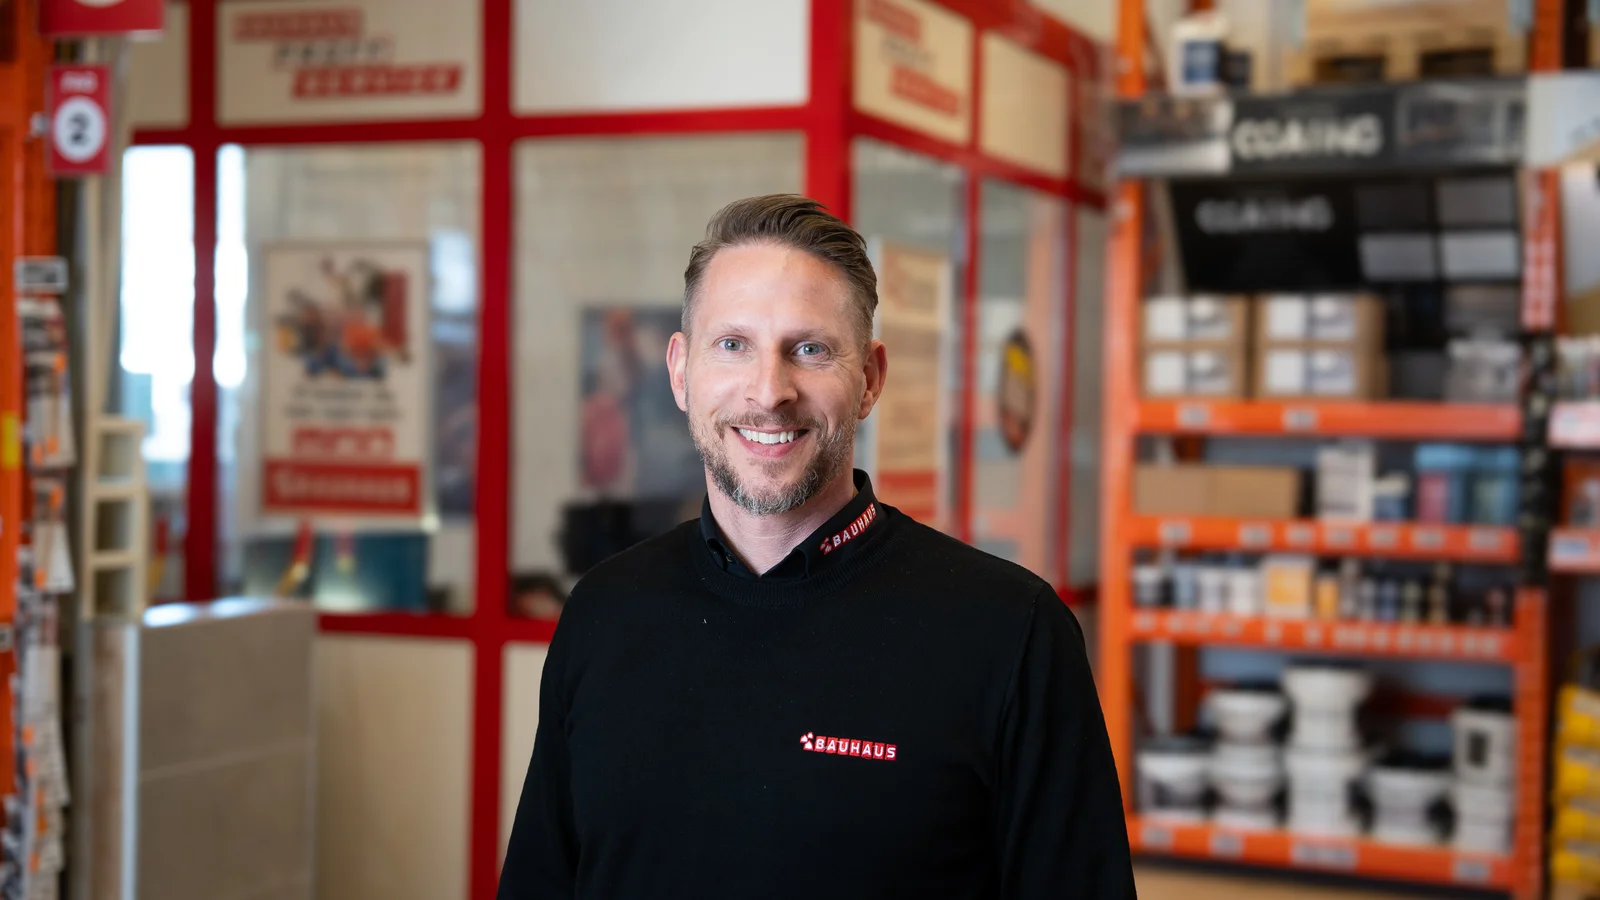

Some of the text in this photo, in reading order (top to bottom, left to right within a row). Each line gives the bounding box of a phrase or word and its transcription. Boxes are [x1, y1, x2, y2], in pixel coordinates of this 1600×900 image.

[67, 111, 91, 147] 2
[832, 504, 876, 547] BAUHAUS
[814, 737, 897, 759] BAUHAUS
